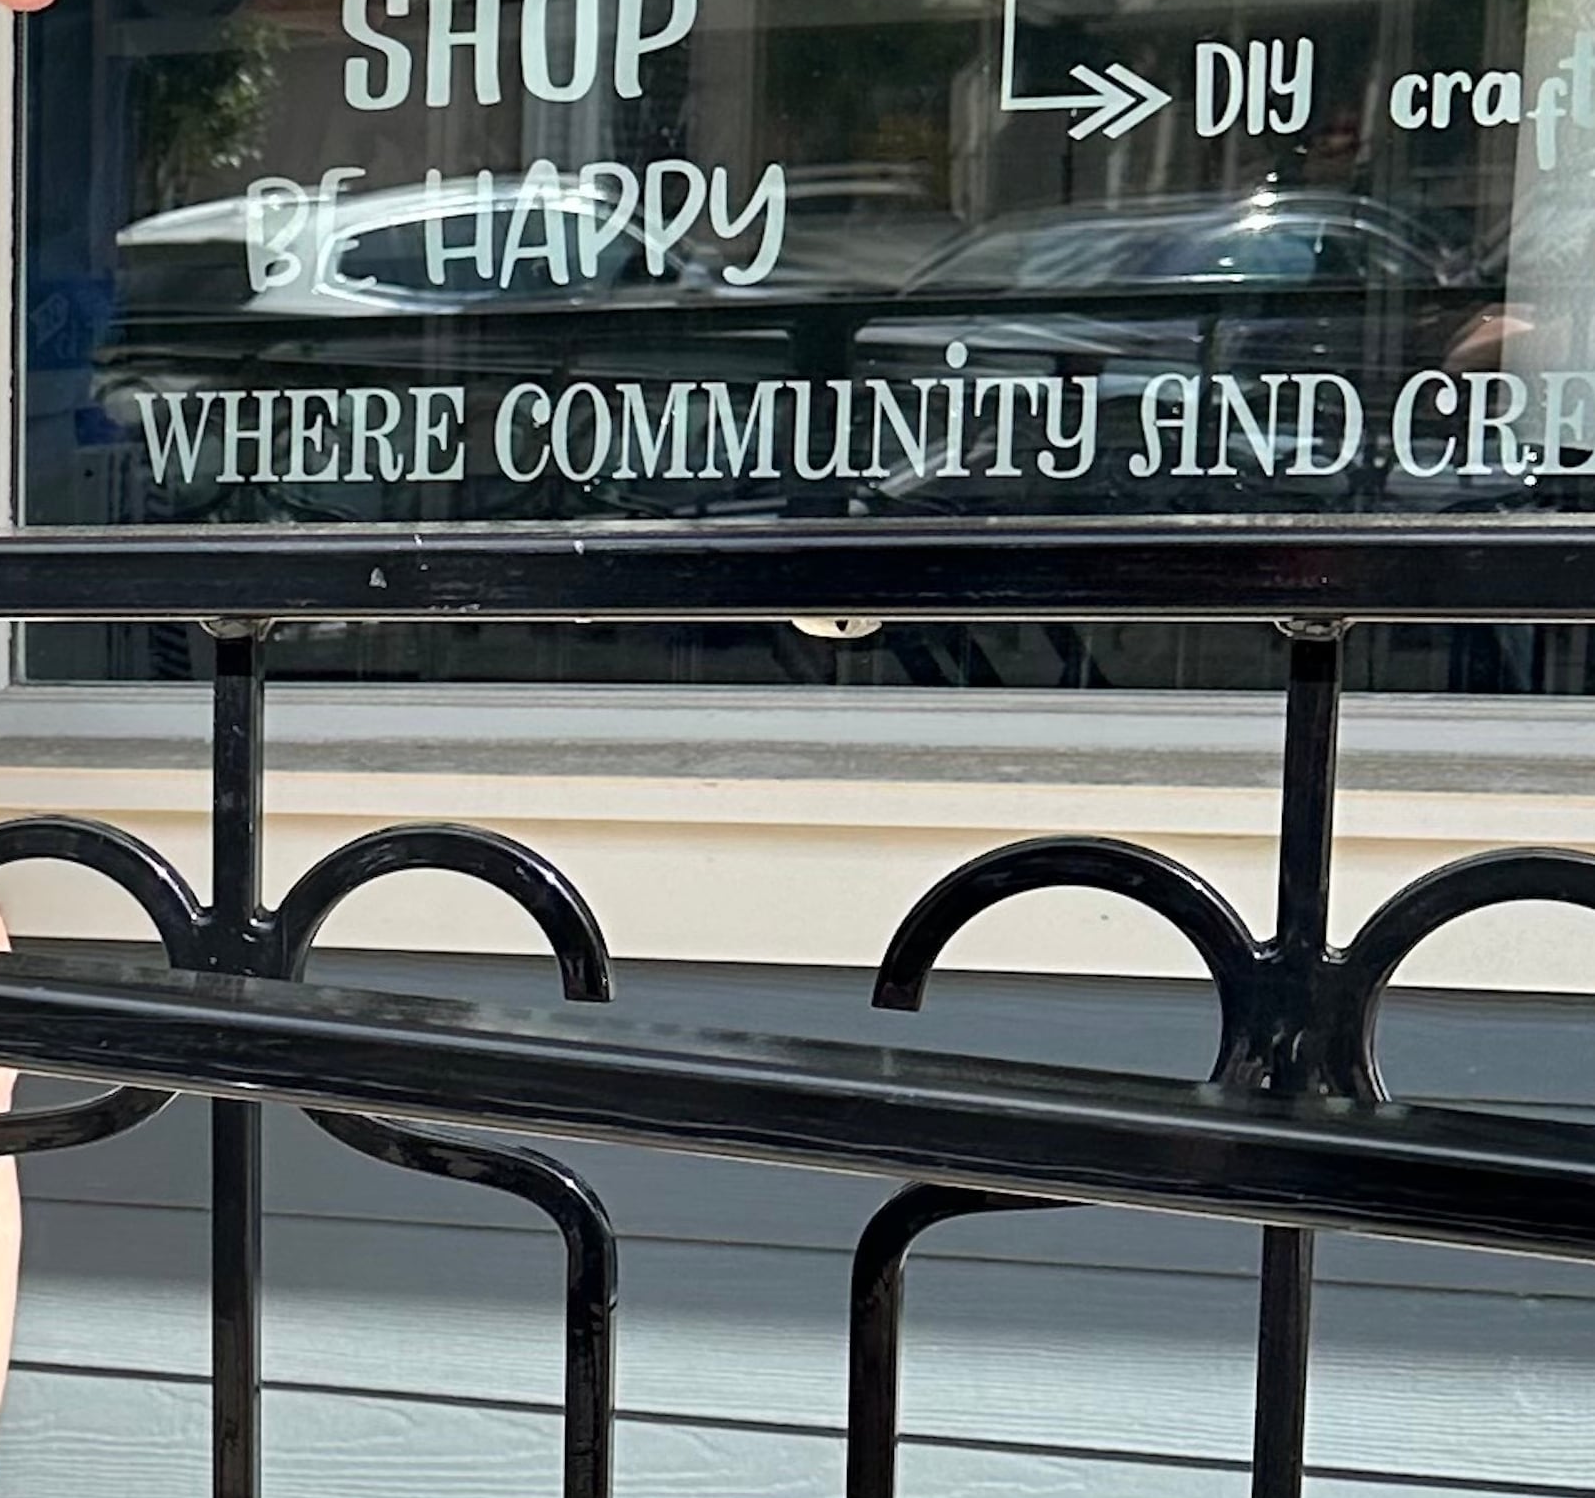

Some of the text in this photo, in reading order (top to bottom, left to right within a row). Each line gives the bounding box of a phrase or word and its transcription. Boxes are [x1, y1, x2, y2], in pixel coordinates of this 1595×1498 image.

[1192, 38, 1314, 139] DIY
[245, 158, 789, 295] BE HAPPY
[130, 386, 466, 485] WHERE
[492, 342, 1101, 486] COMMUNITY
[1130, 370, 1361, 479] AND
